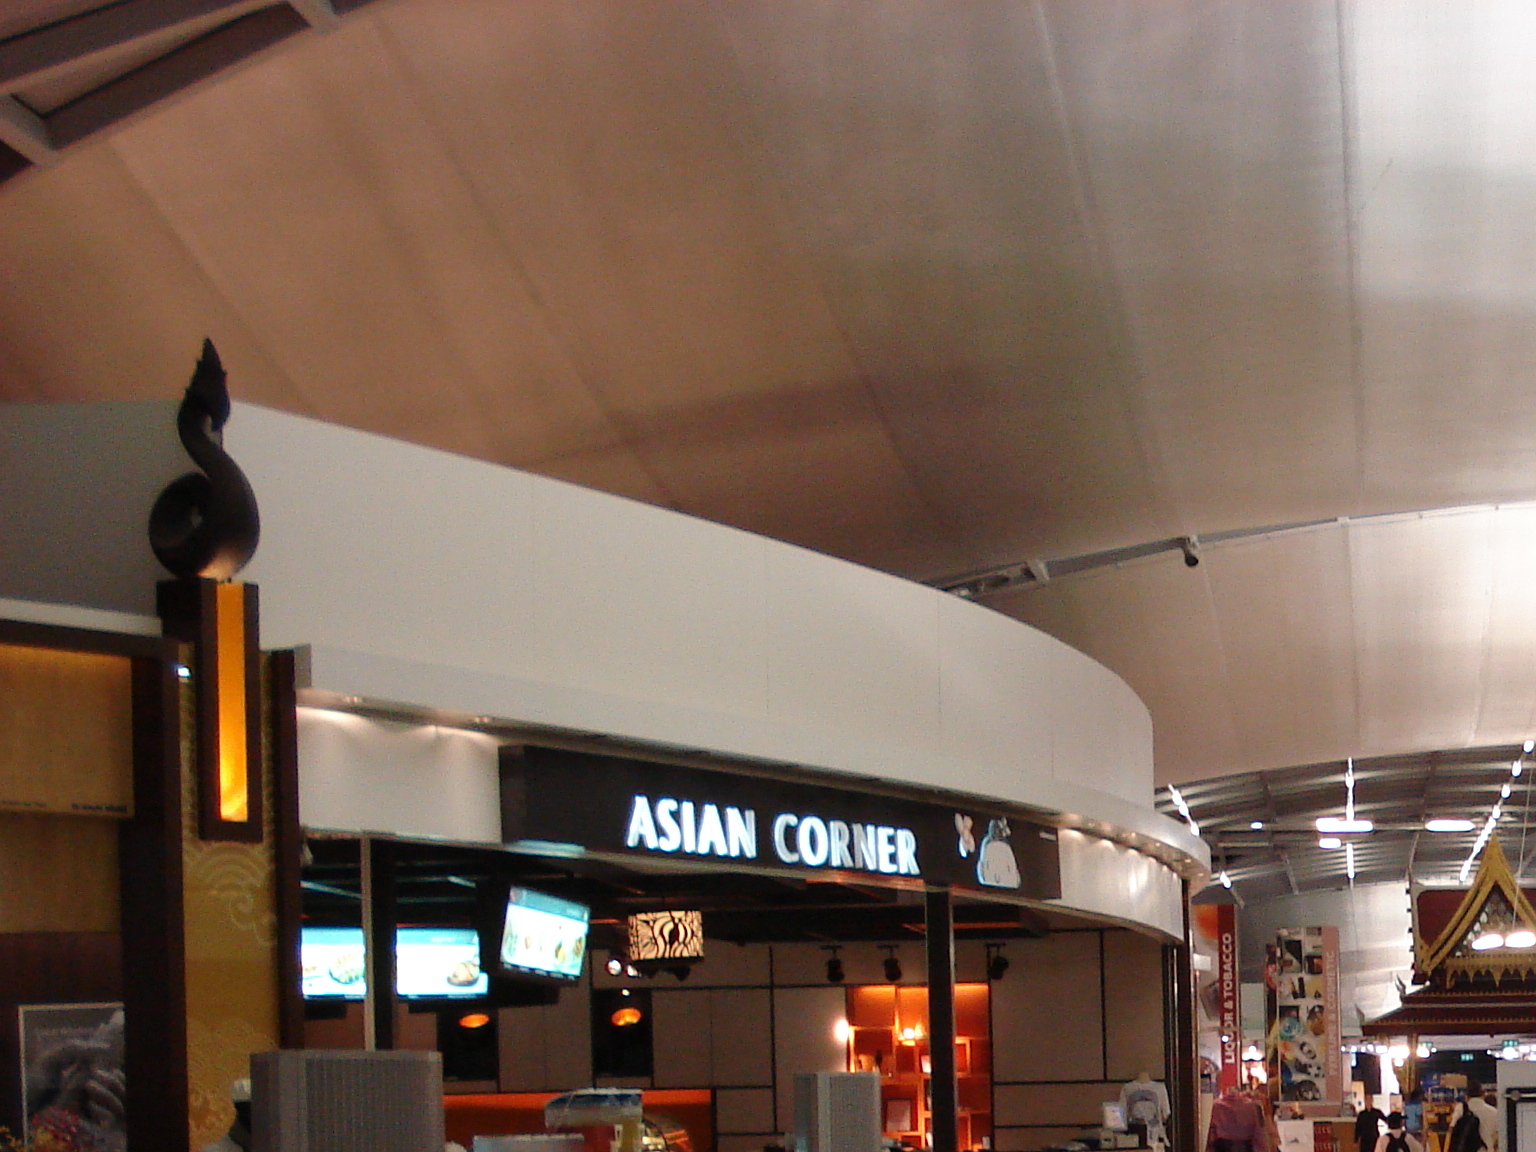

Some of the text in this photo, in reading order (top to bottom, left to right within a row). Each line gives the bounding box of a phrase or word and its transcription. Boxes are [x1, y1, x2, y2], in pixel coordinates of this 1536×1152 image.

[627, 794, 920, 876] ASIAN CORNER
[1222, 932, 1234, 998] TOBACCO
